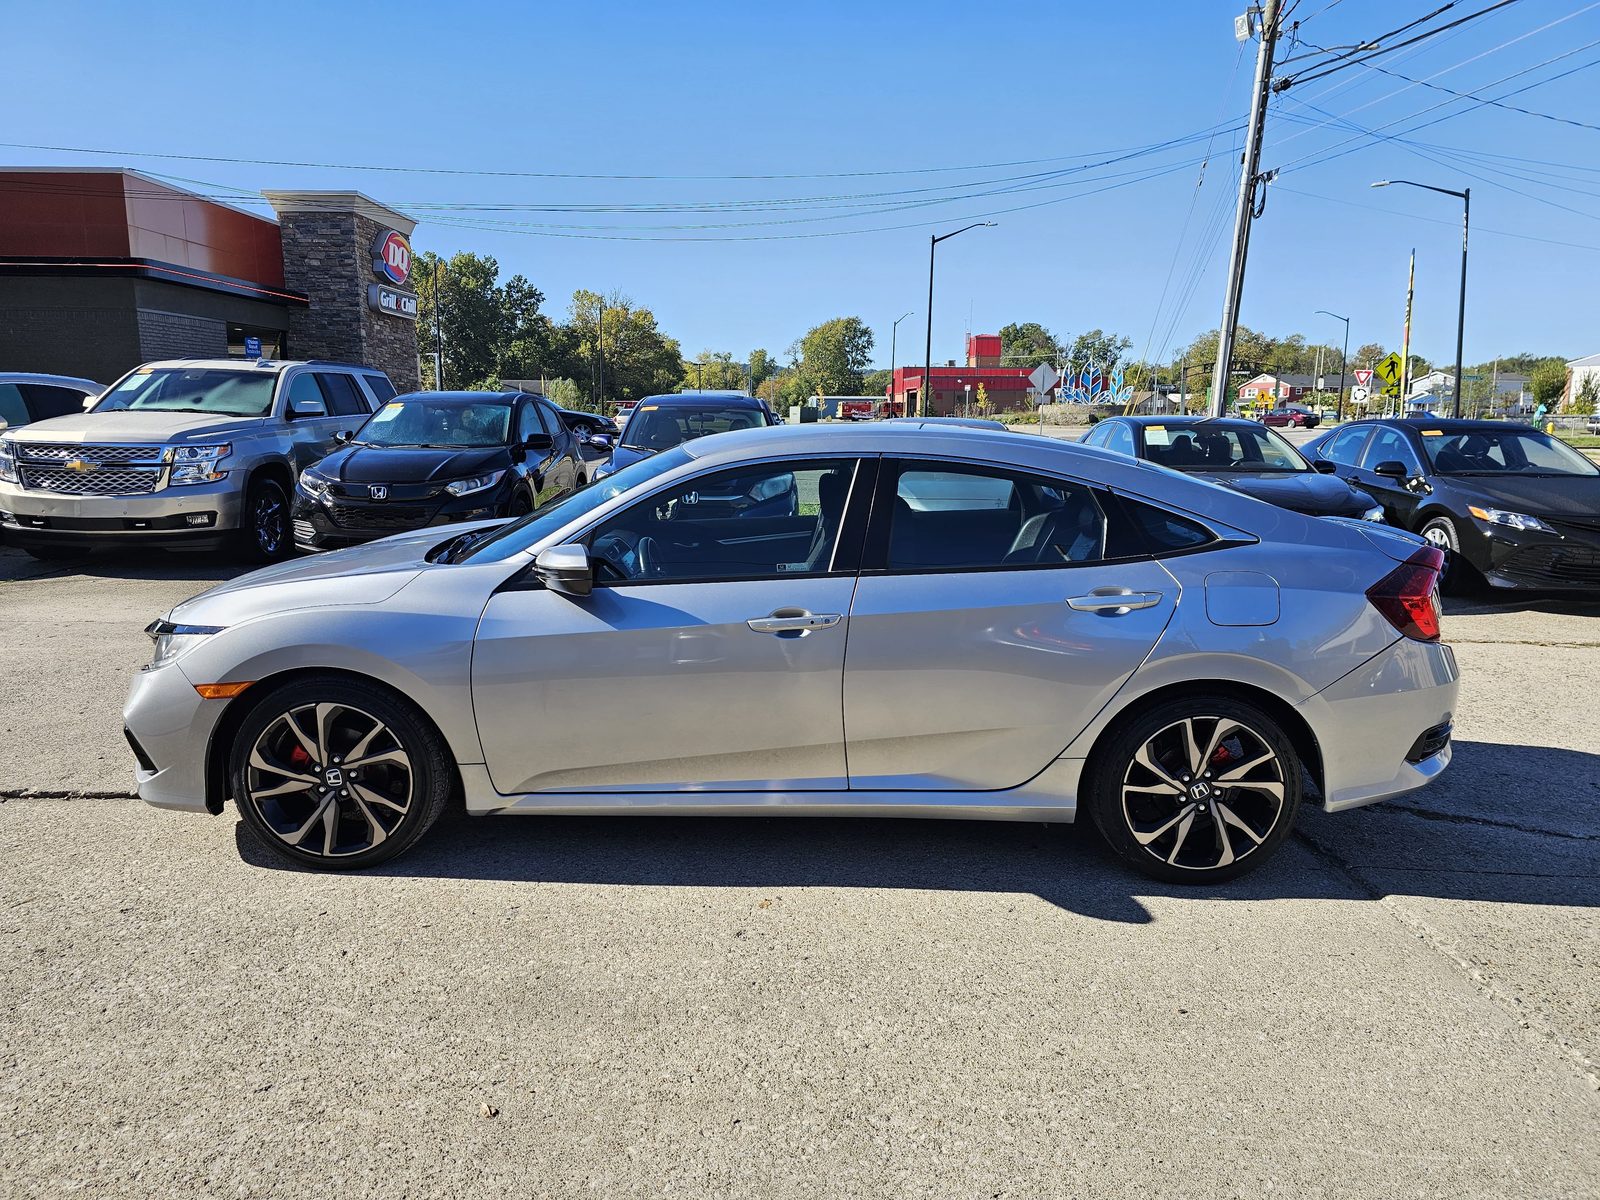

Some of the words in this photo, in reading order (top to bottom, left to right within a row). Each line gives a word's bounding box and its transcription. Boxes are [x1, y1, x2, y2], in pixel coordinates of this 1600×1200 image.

[389, 242, 408, 274] DQ
[381, 291, 396, 310] Grill
[401, 297, 416, 314] Chill
